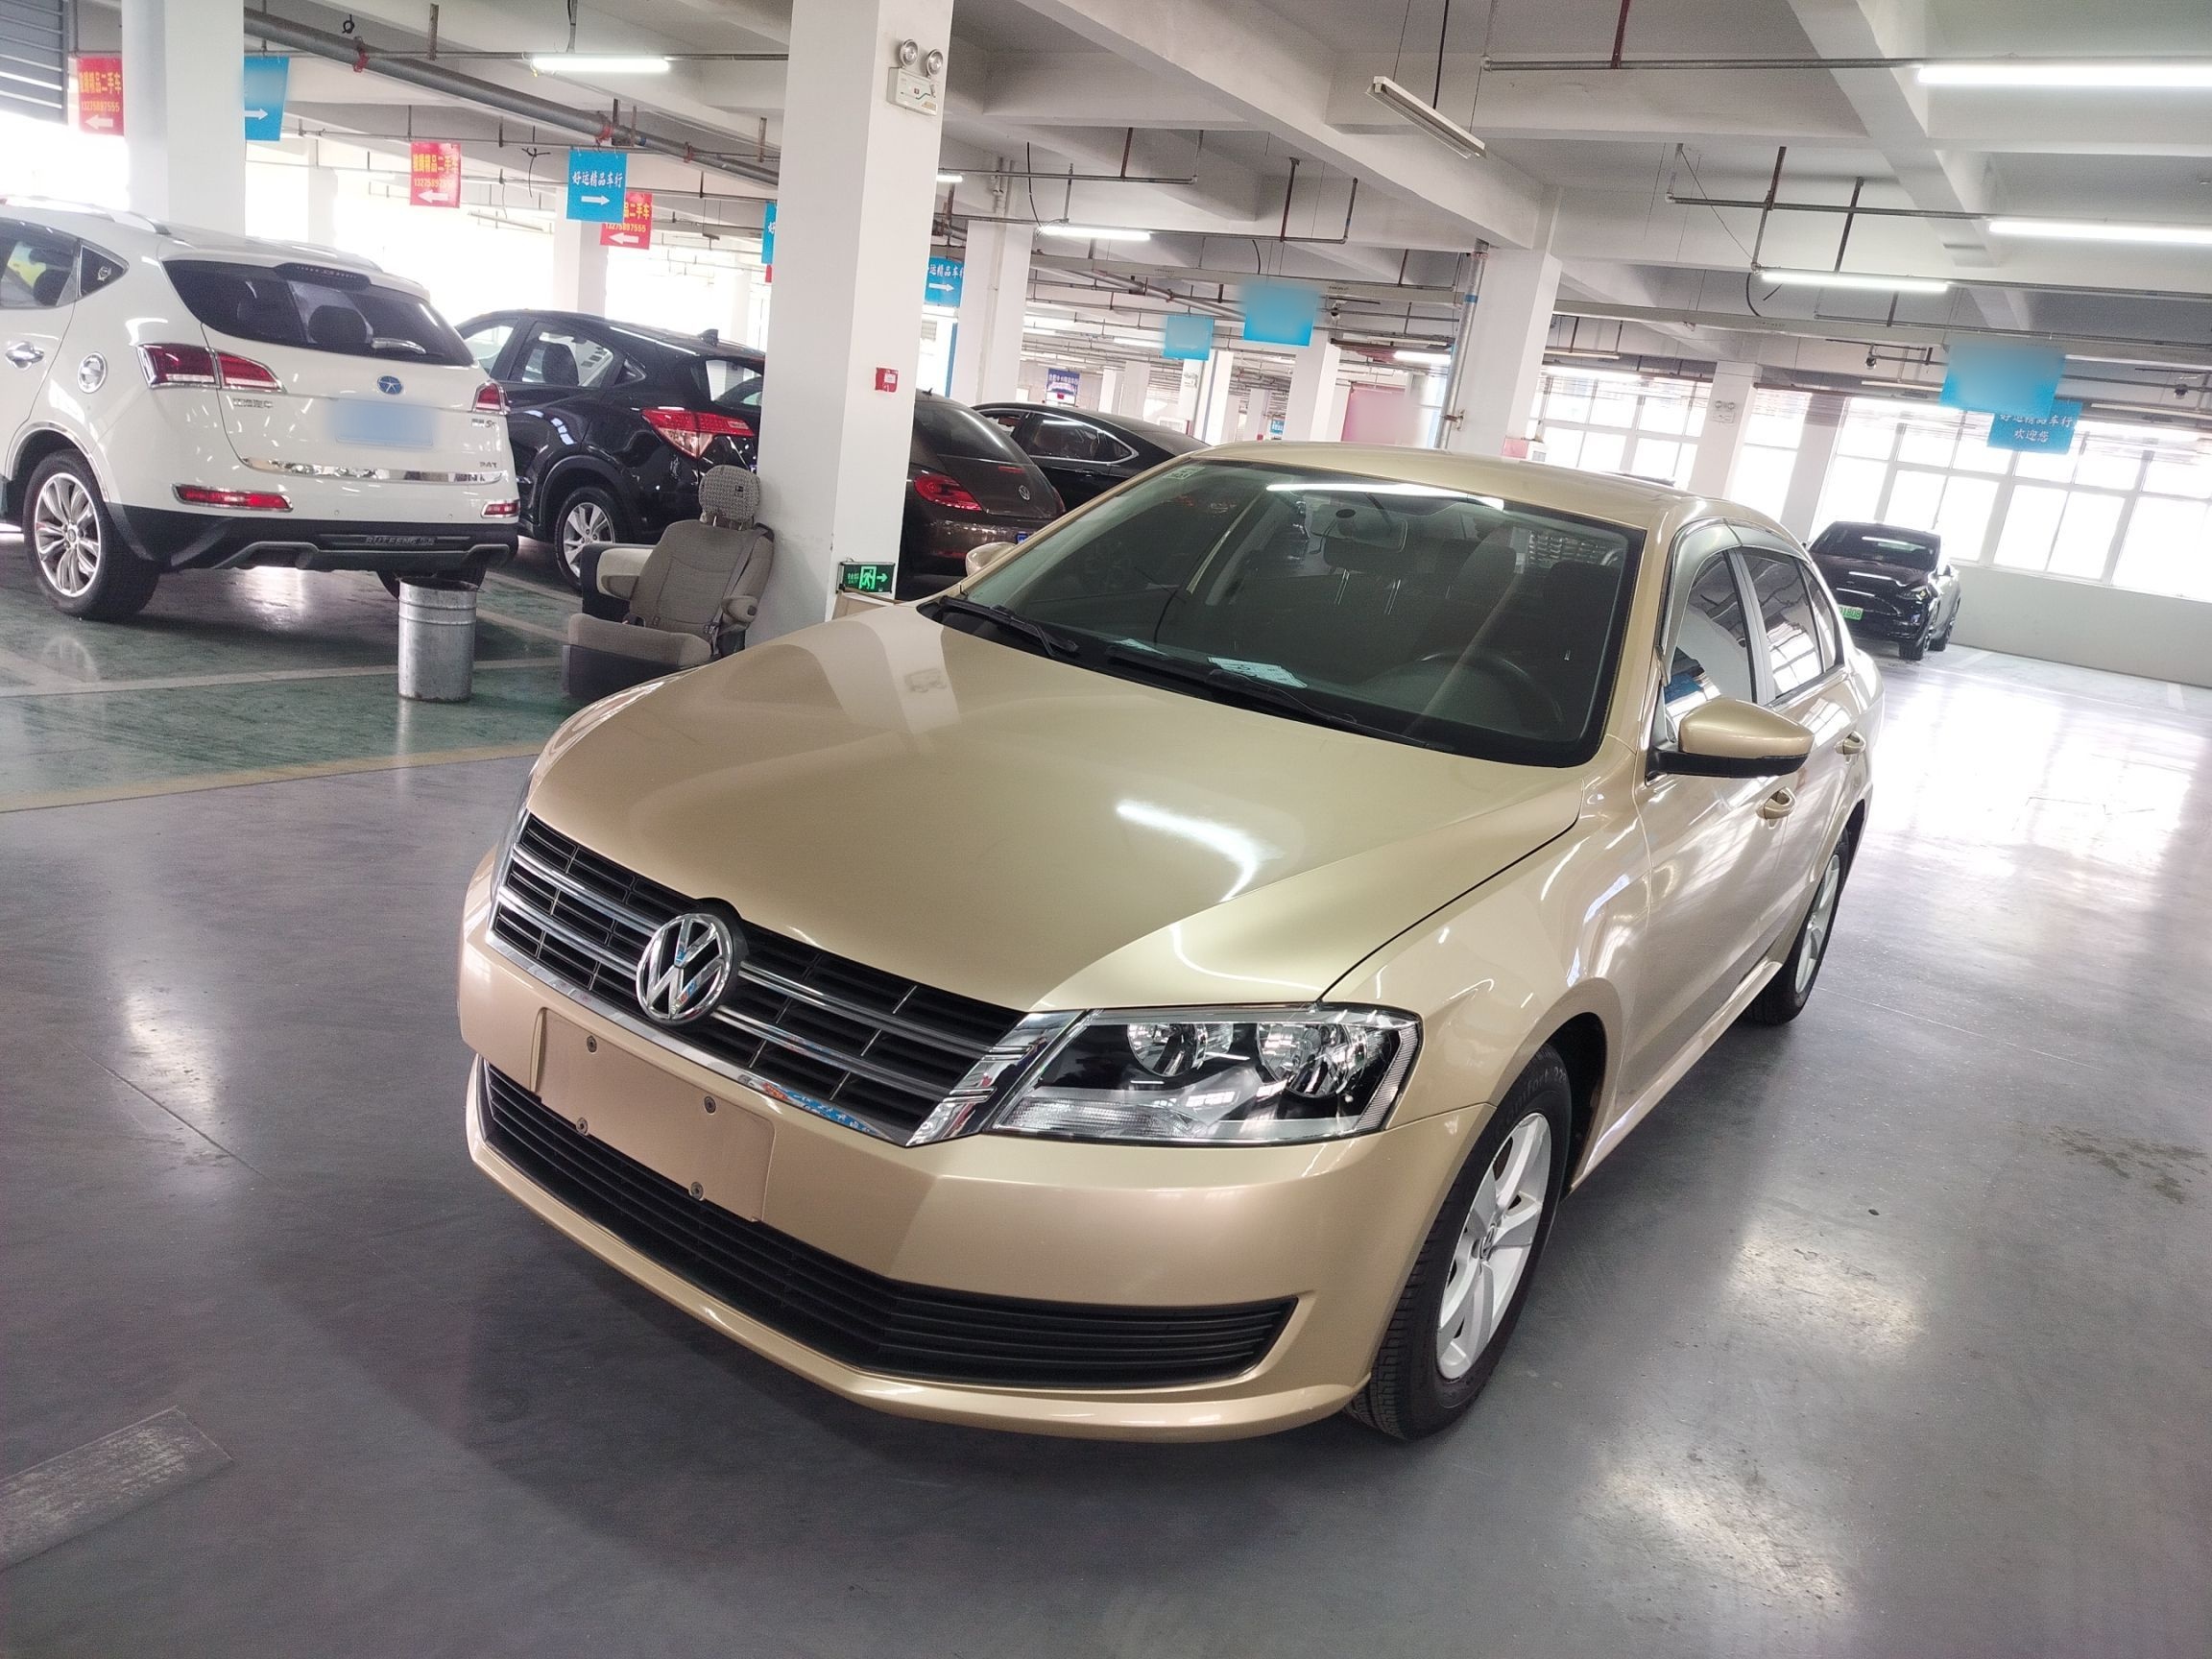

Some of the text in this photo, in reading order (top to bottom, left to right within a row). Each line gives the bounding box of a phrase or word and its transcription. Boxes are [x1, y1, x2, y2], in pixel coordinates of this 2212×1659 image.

[572, 170, 623, 188] 好运精品车行
